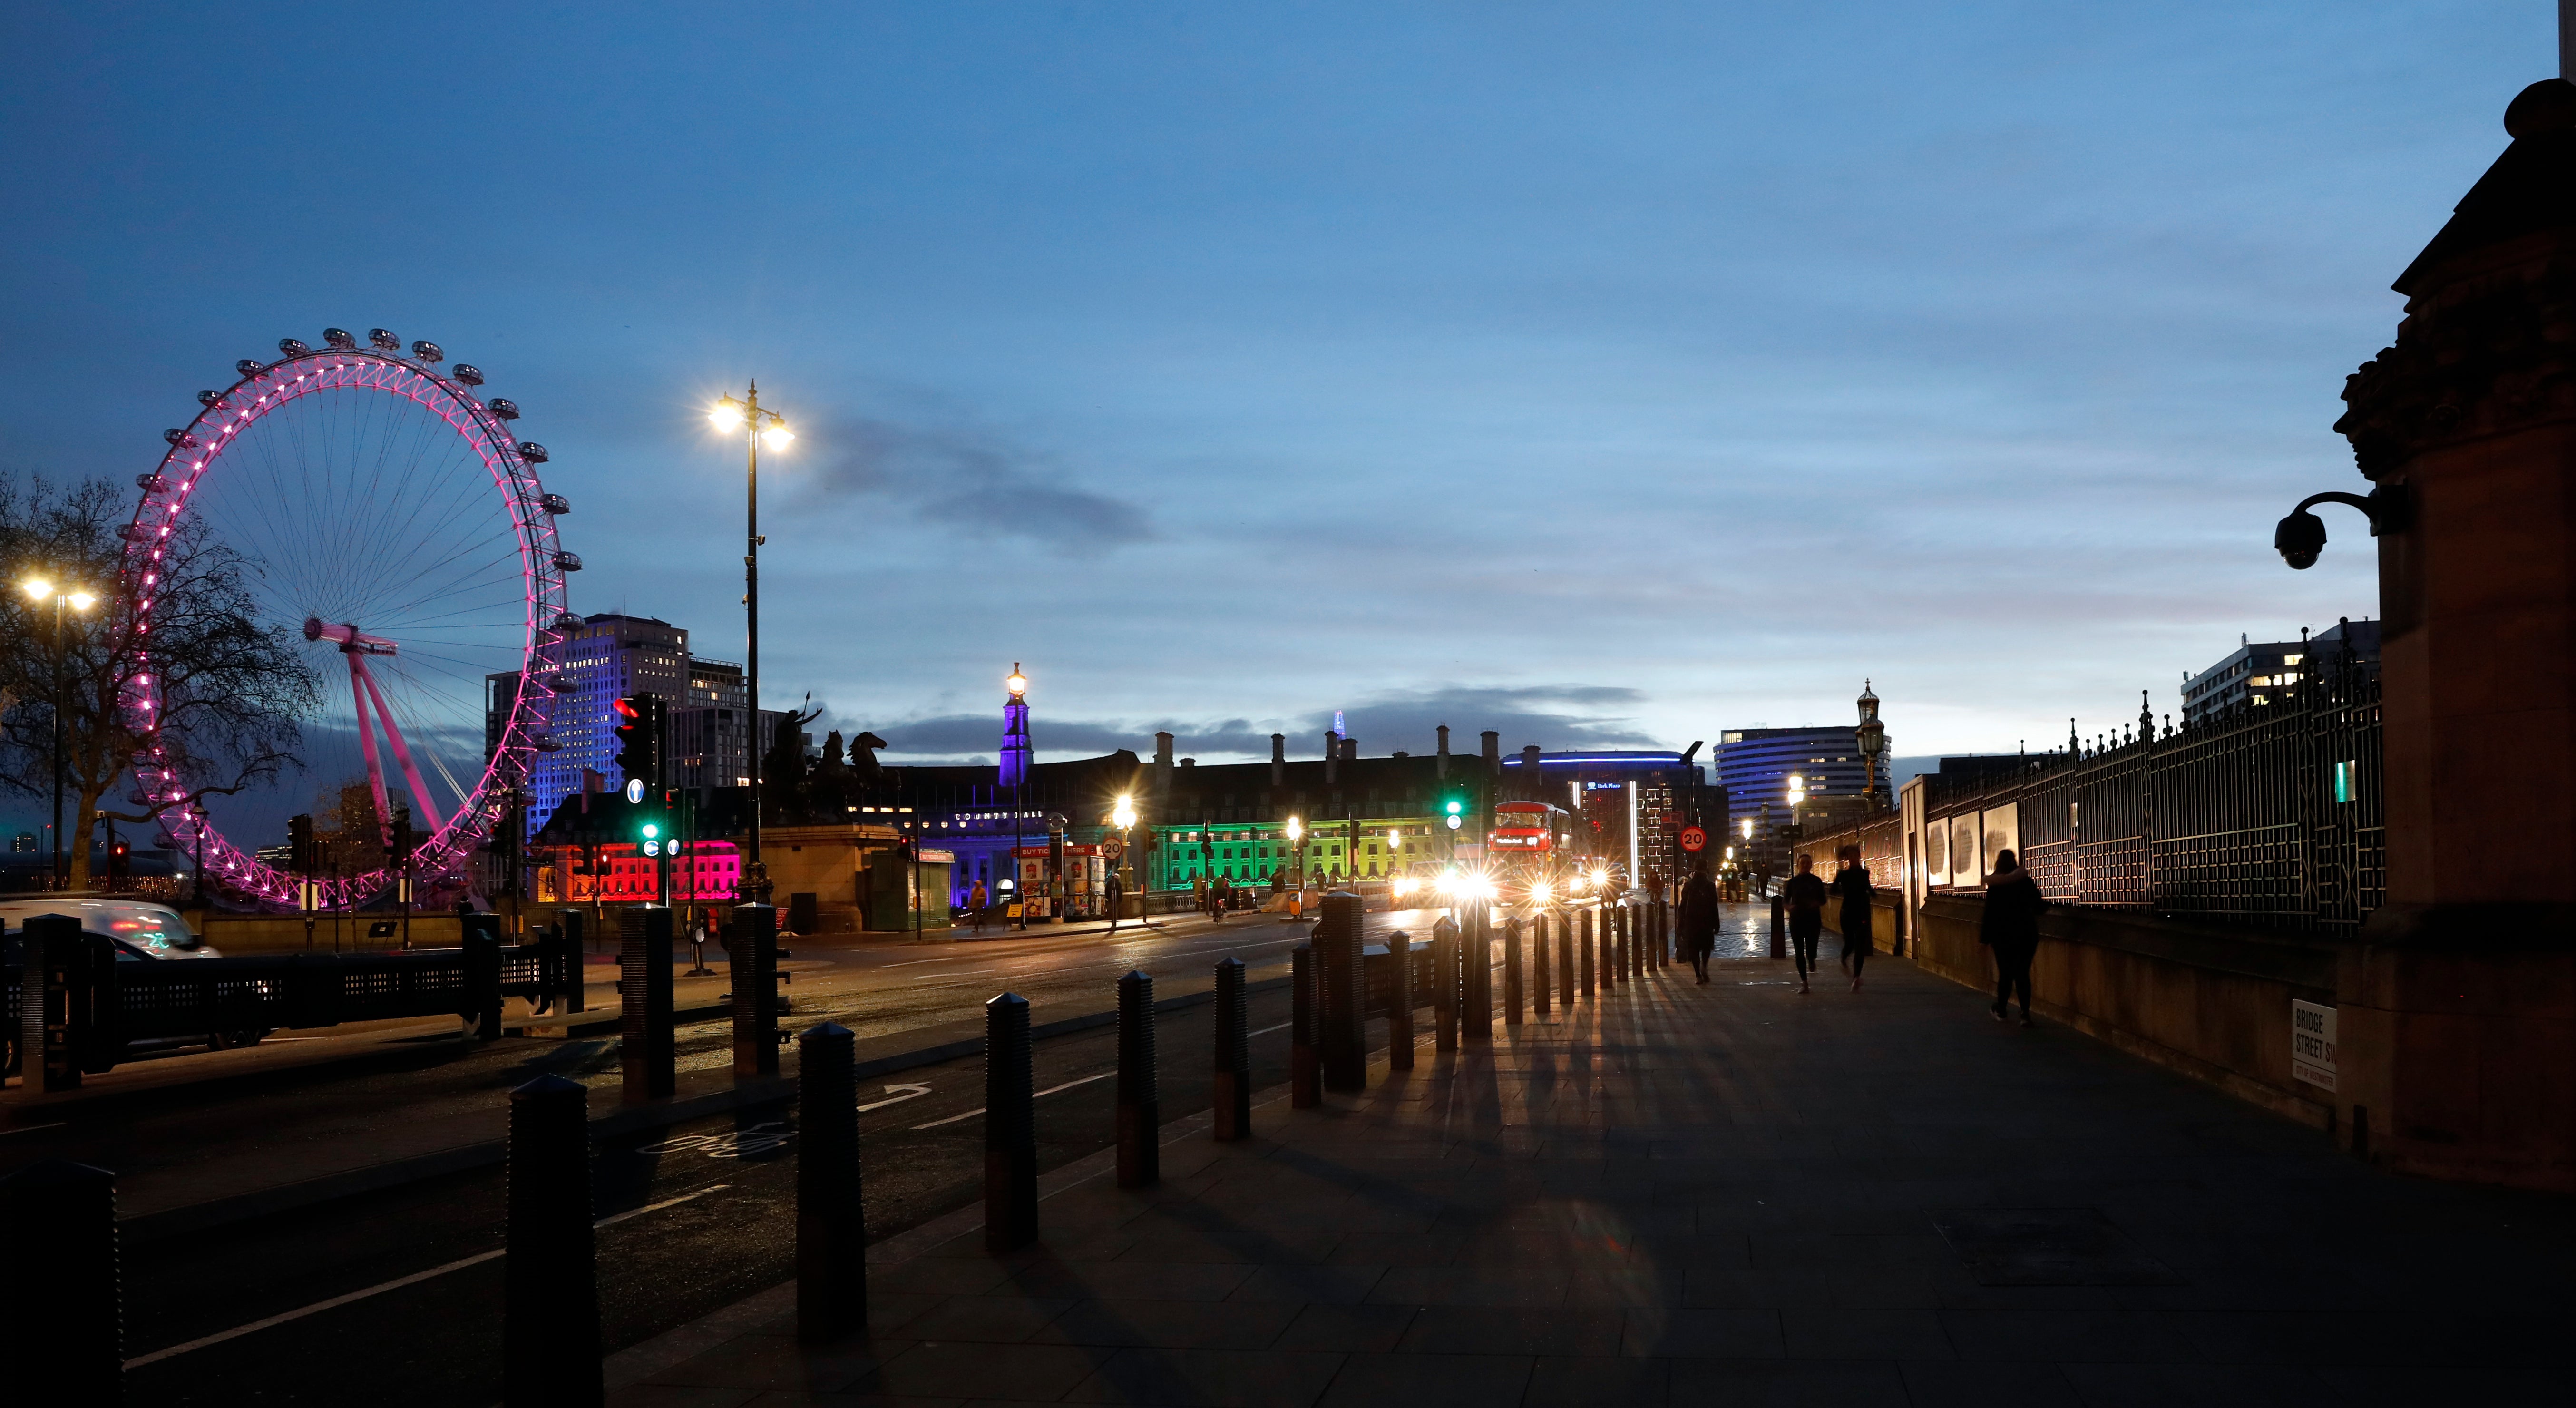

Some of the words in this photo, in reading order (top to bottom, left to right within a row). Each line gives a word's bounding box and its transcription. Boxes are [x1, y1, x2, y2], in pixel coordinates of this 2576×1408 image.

[955, 812, 1007, 820] COUNTY
[1527, 837, 1538, 845] 159
[1684, 834, 1702, 844] 20
[1105, 844, 1120, 853] 20
[2297, 1008, 2323, 1034] BRIDGE
[2296, 1033, 2323, 1059] STREET
[2304, 1068, 2308, 1077] OF
[2310, 1071, 2333, 1086] WESTMINSTER
